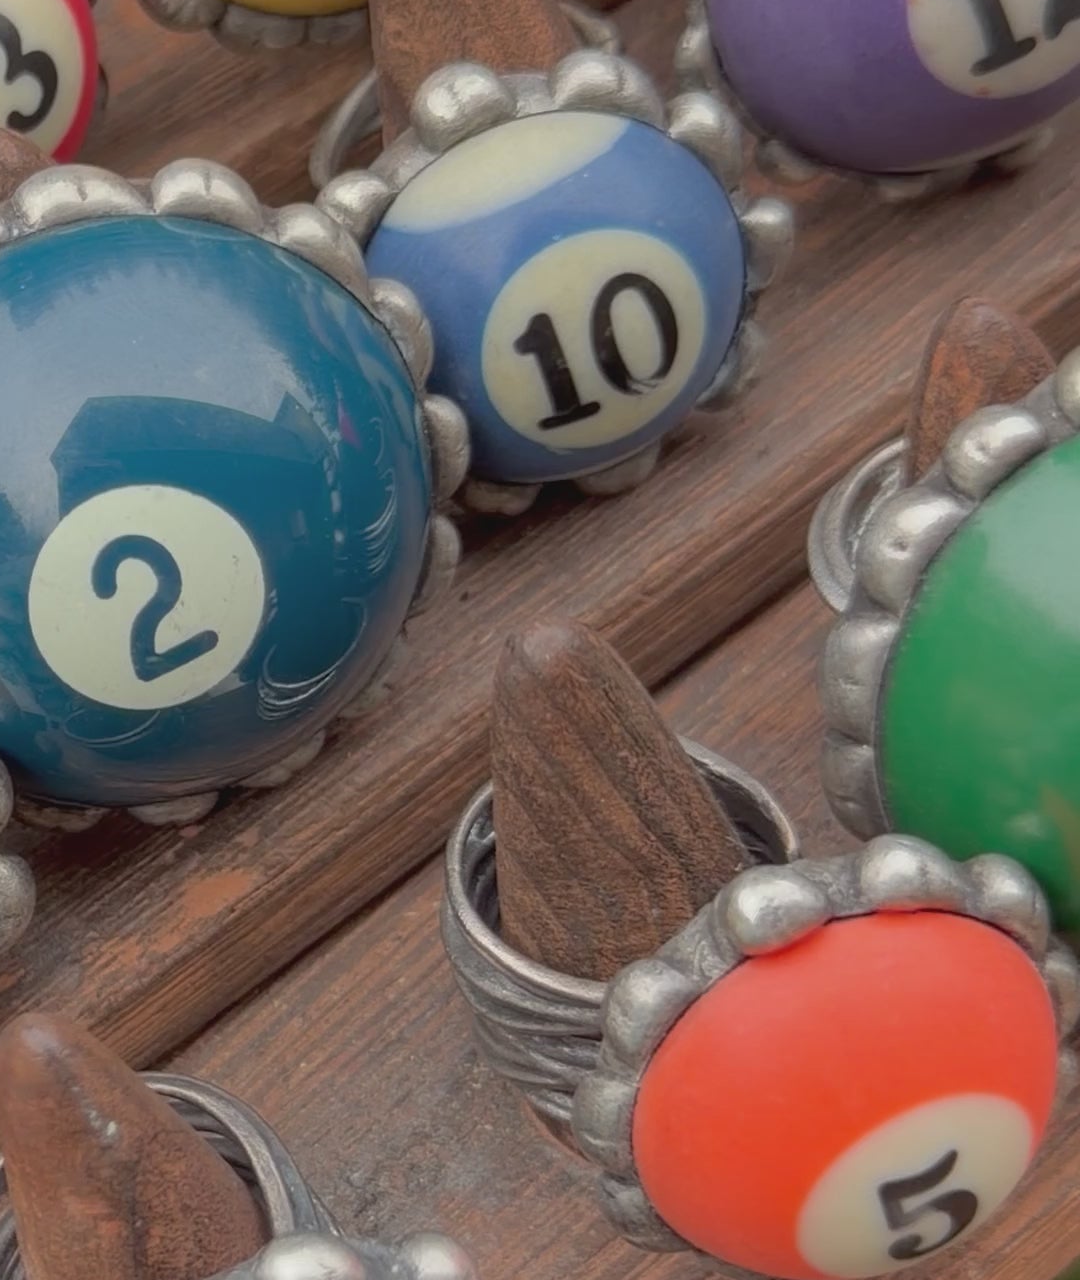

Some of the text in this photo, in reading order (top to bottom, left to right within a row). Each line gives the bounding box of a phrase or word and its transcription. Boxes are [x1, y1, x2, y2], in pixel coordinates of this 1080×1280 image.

[512, 270, 679, 431] 10
[91, 533, 219, 683] 2
[876, 1149, 979, 1261] 5
